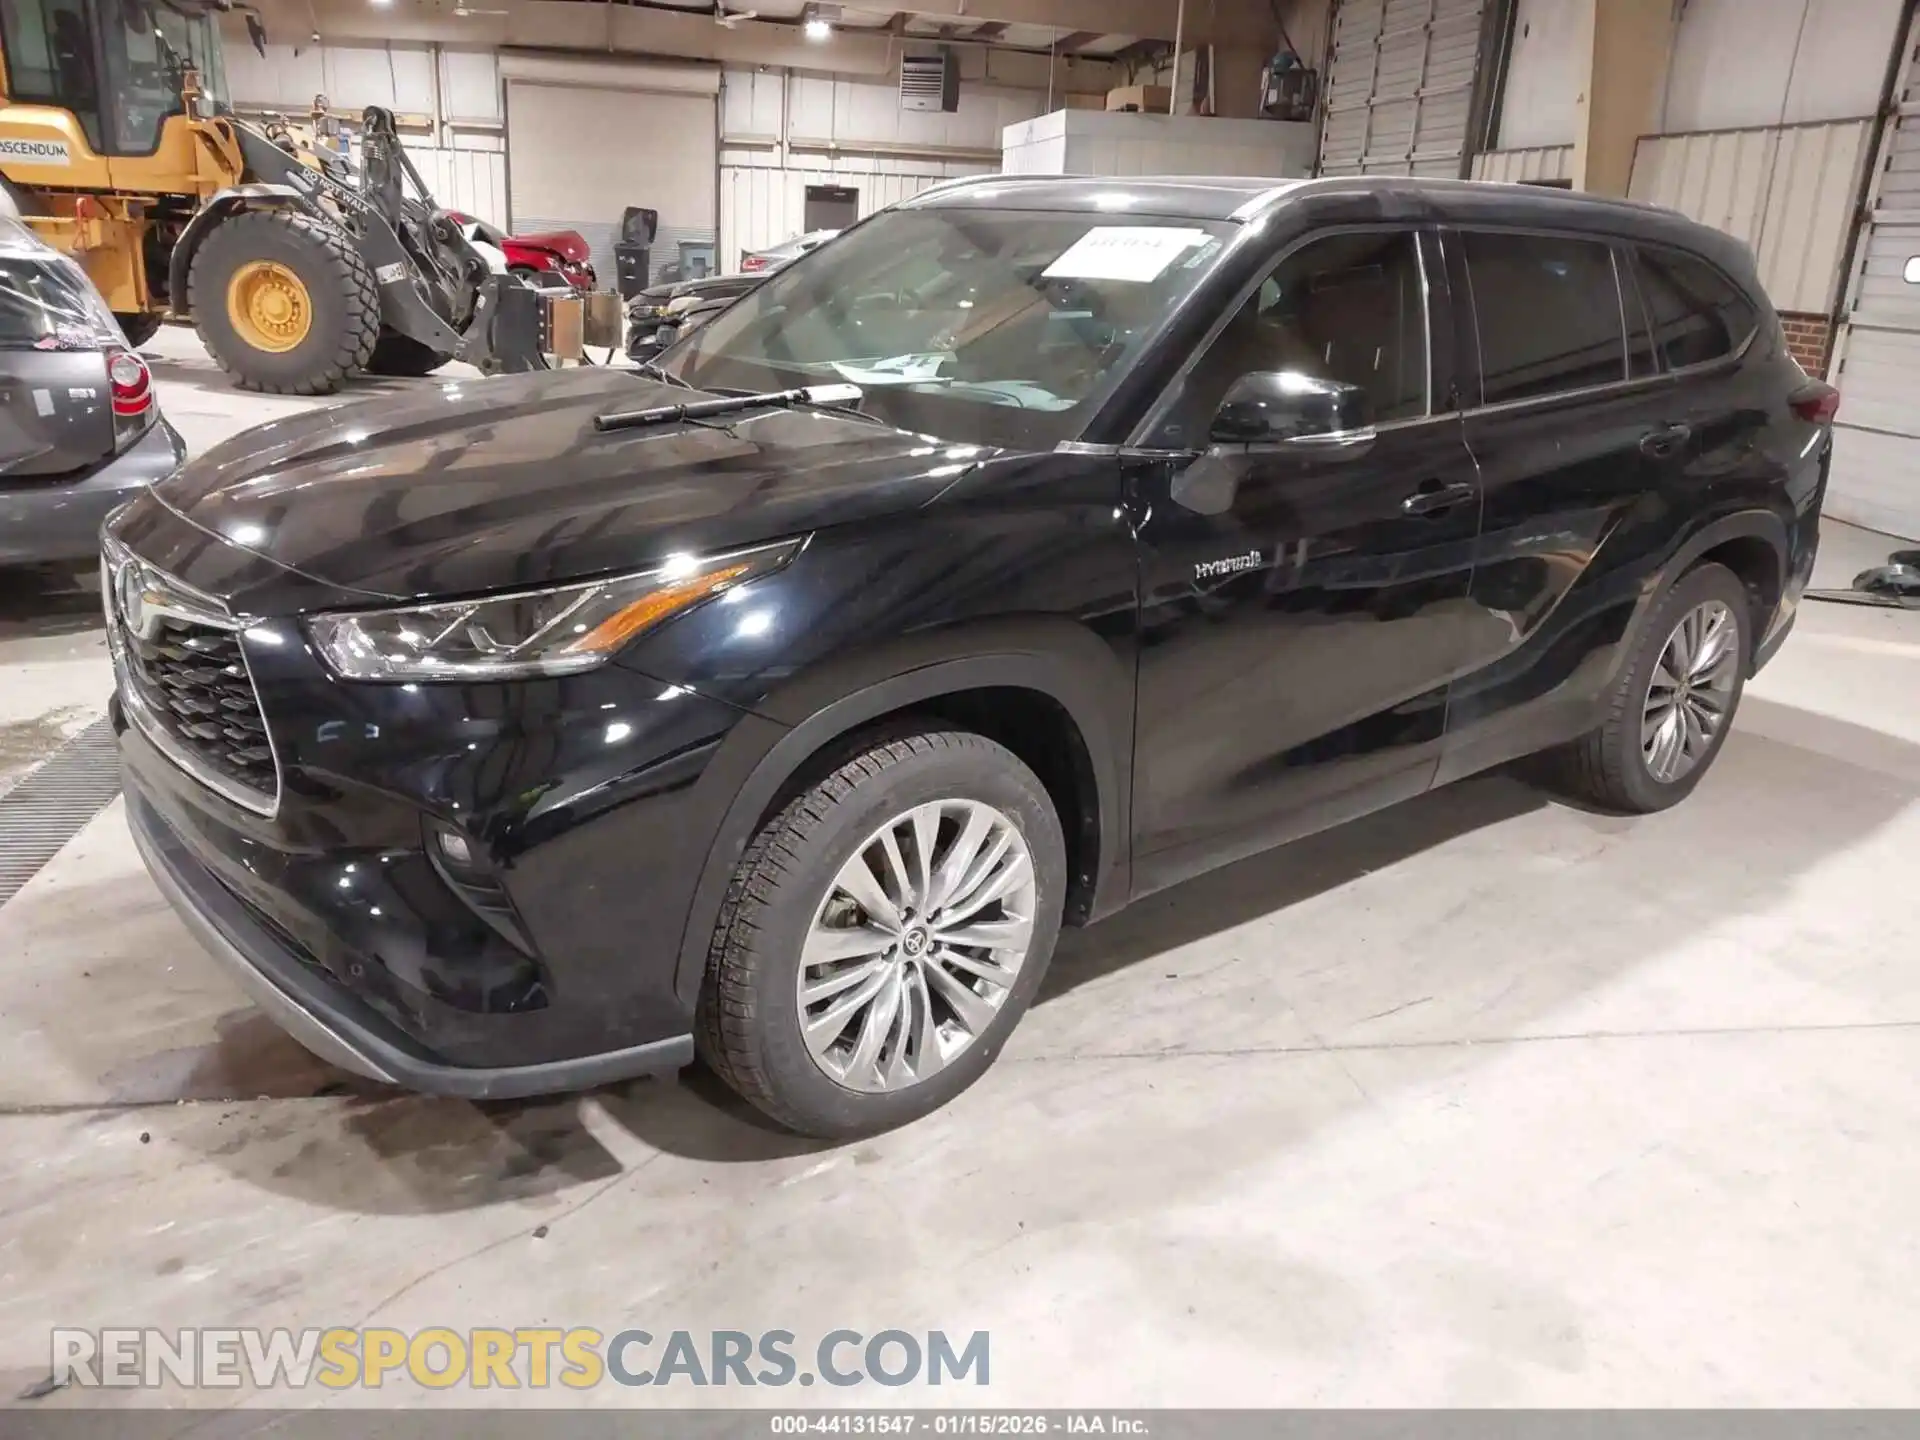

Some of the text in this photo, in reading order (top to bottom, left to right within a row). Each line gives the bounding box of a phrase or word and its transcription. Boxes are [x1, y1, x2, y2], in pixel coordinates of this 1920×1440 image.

[303, 167, 369, 215] DO NOT WALK
